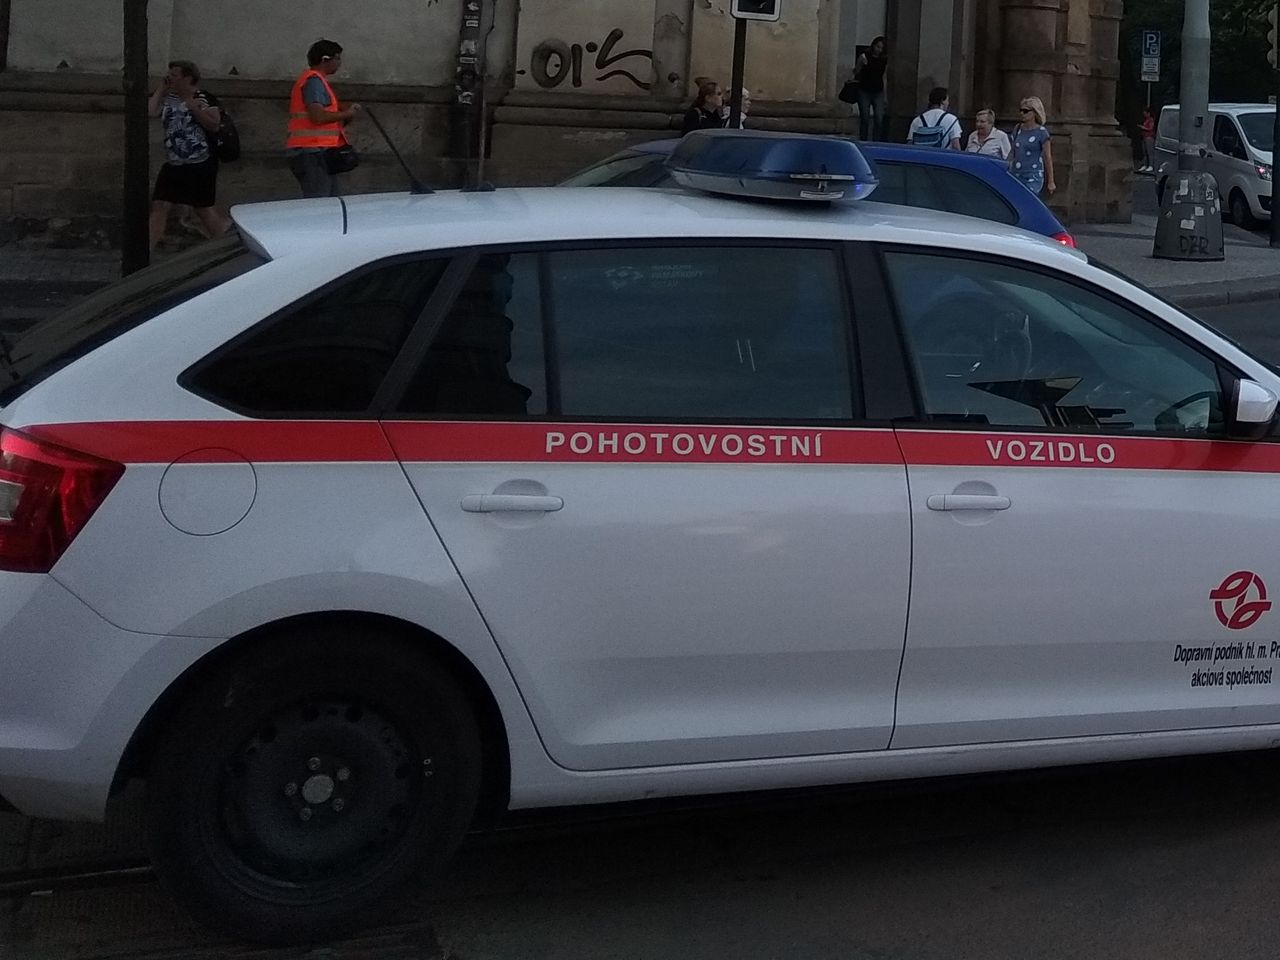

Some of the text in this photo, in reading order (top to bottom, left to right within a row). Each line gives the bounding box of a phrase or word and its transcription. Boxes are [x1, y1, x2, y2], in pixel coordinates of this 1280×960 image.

[1146, 33, 1157, 49] P
[545, 431, 1116, 464] POHOTOVOSTNÍ VOZIDLO
[1173, 641, 1216, 667] Dopravní
[1213, 641, 1245, 666] podnik
[1244, 641, 1256, 660] hl.
[1256, 644, 1268, 660] m.
[1190, 665, 1273, 691] akciová společnost
